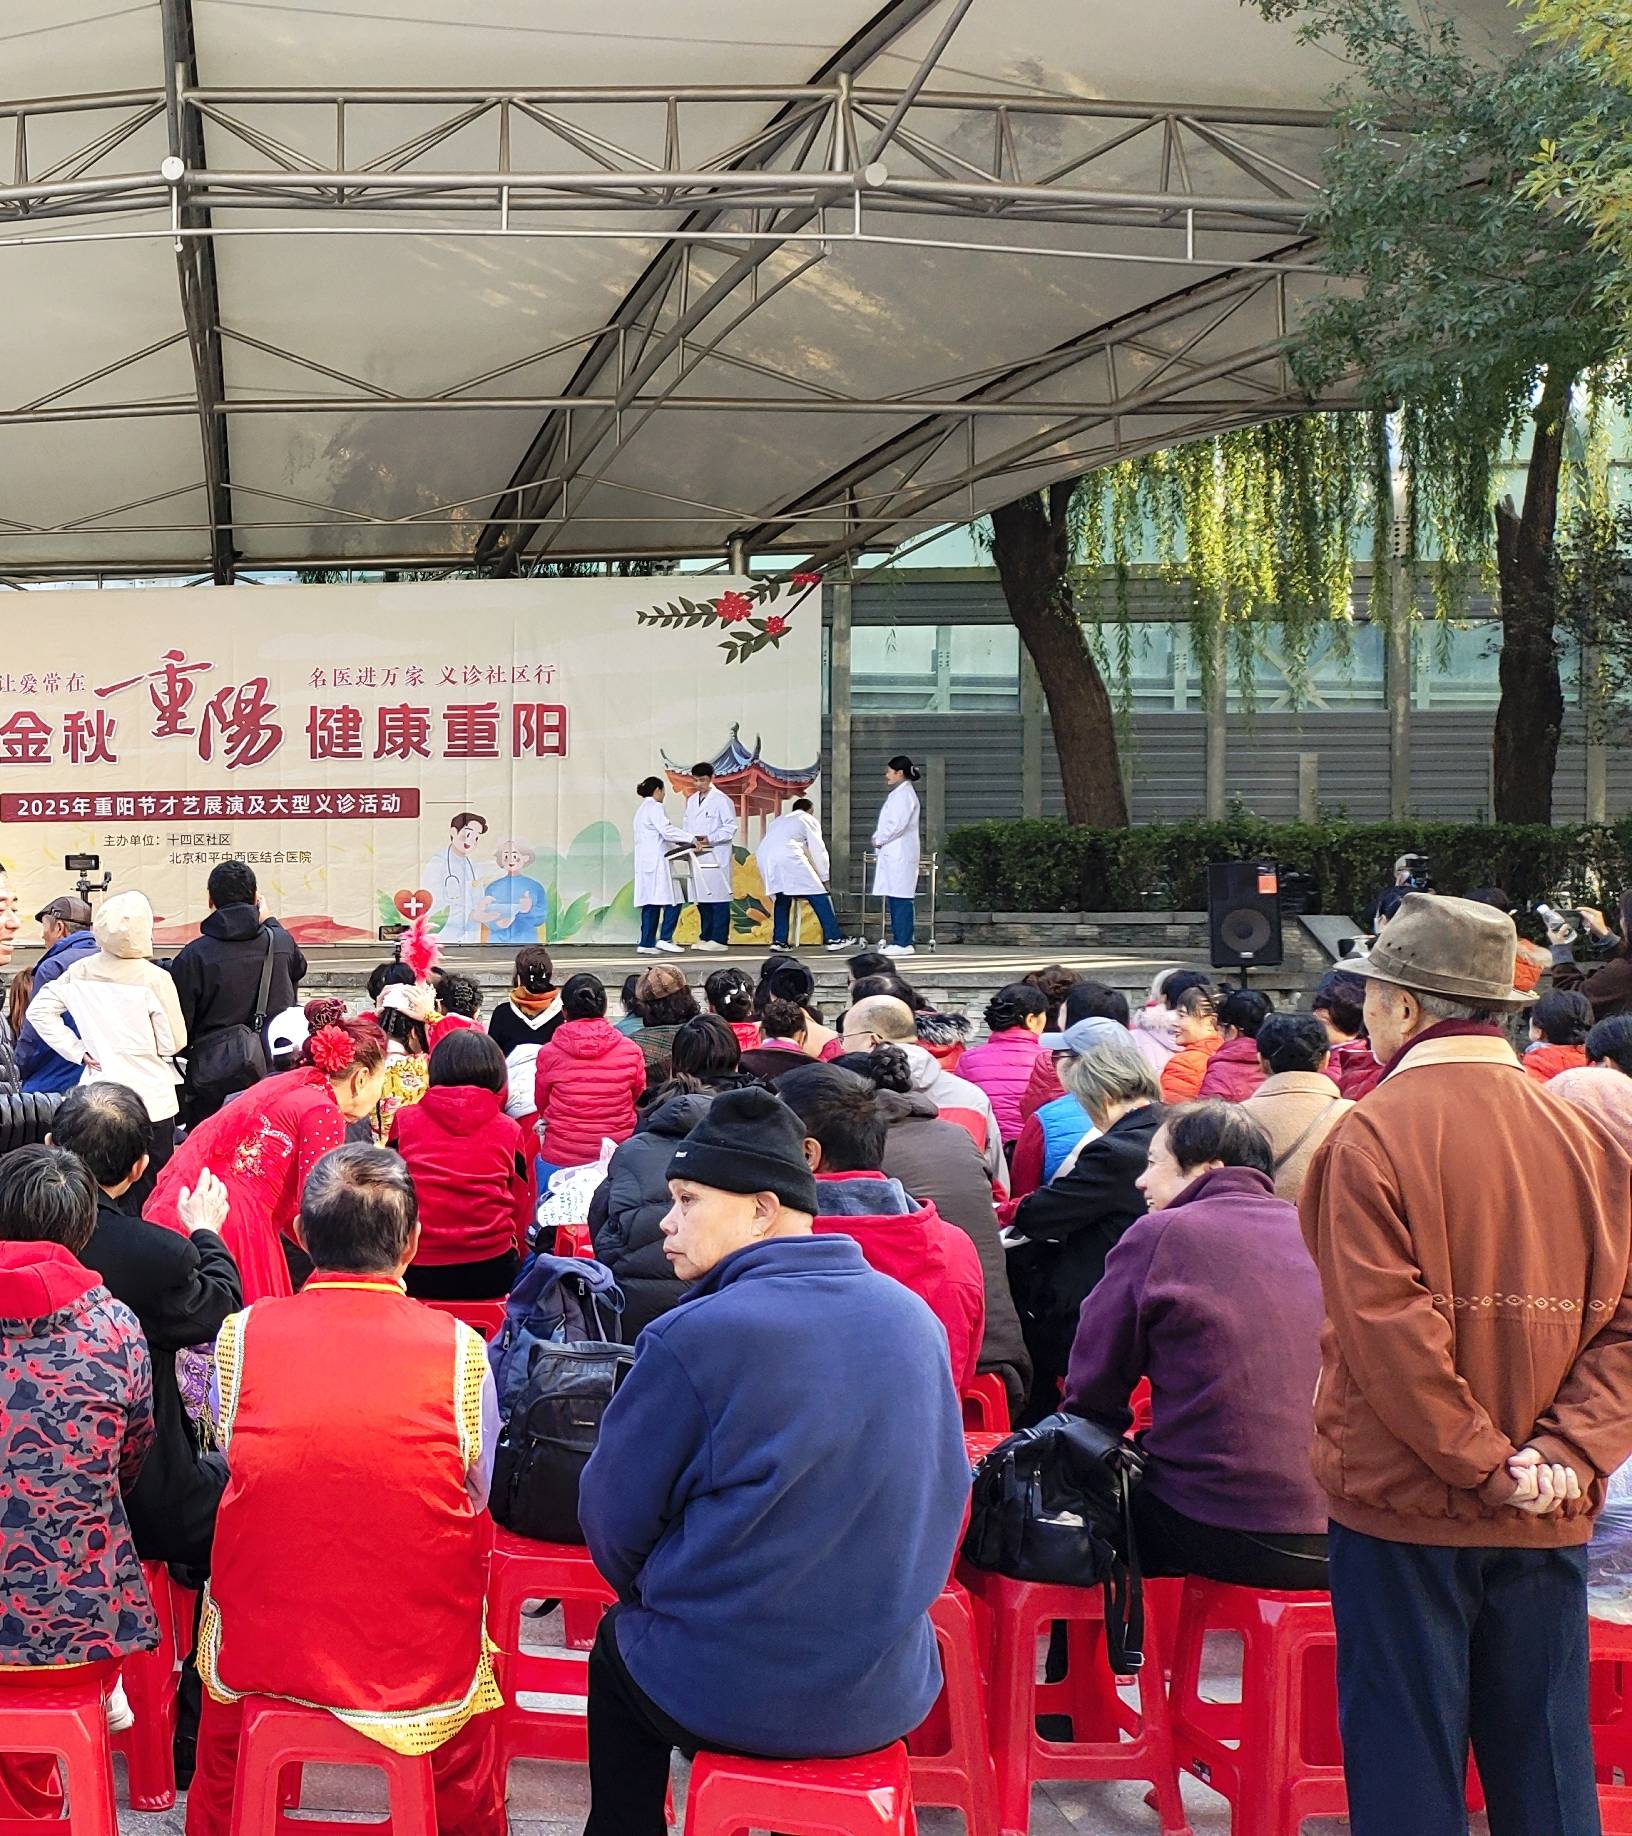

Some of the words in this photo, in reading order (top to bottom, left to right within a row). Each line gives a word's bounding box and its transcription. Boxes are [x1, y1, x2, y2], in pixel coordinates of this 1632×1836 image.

[308, 665, 425, 689] 名医进万家
[435, 664, 557, 686] 义诊社区行
[305, 701, 570, 761] 健康重阳
[17, 793, 402, 818] 2025年重阳节才艺展演及大型义诊活动
[168, 850, 313, 865] 北京和平中西医结合医院
